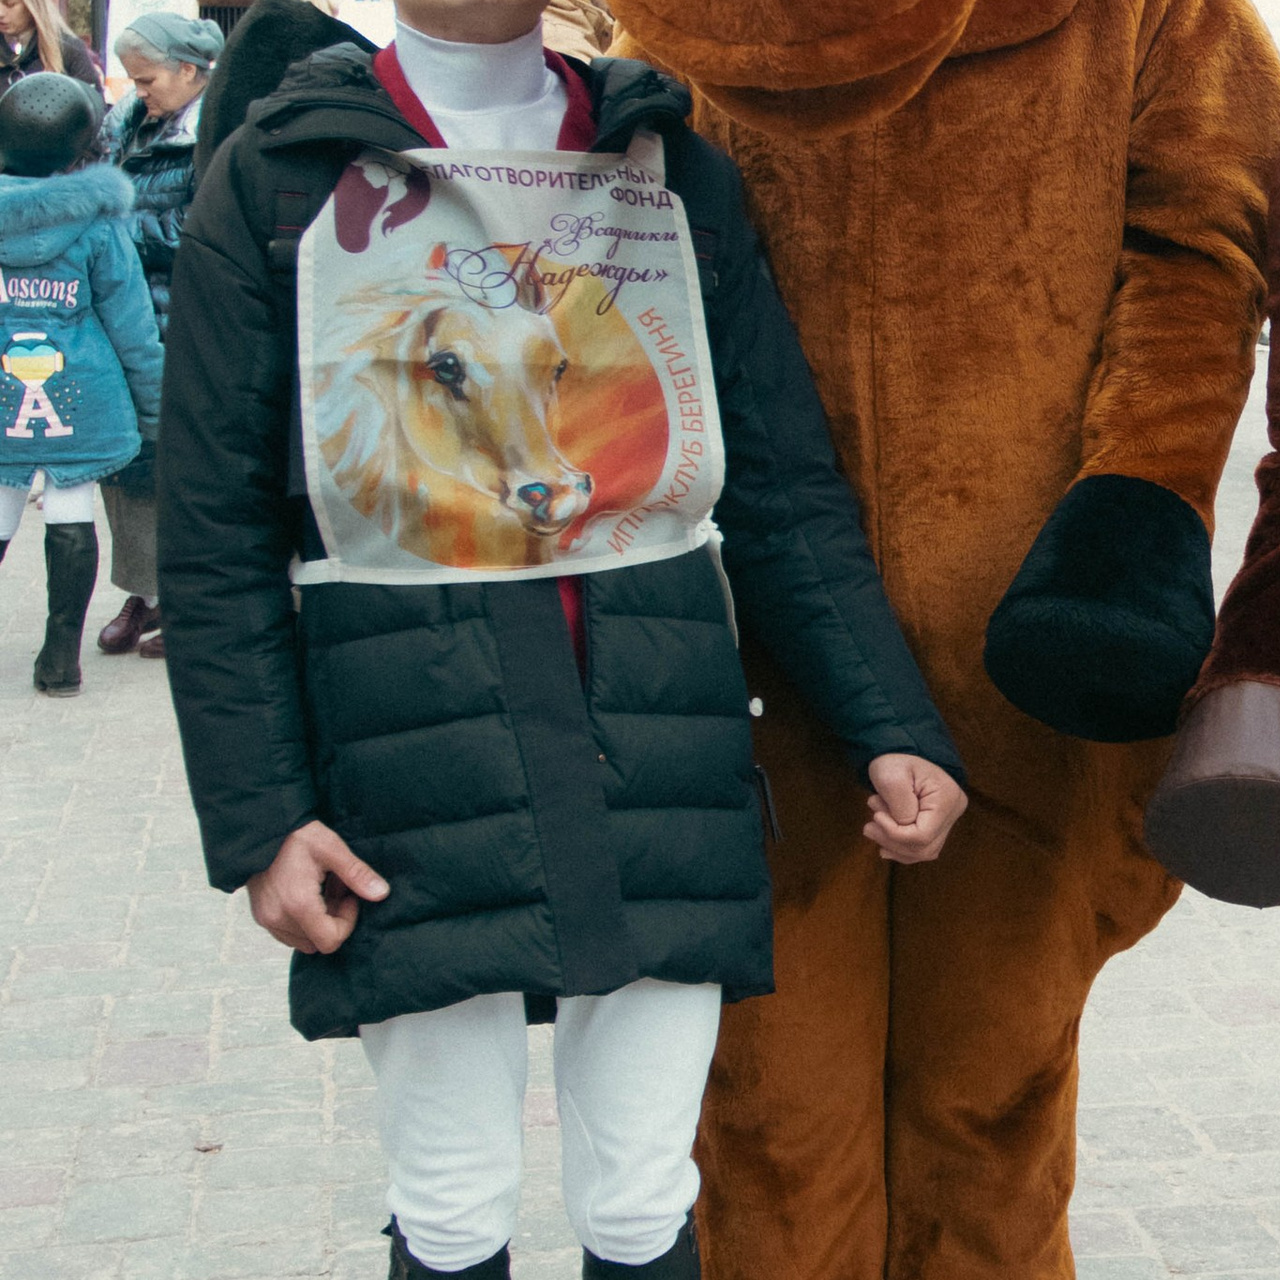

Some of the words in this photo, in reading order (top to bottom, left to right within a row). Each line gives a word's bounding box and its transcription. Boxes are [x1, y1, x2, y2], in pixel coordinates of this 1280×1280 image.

[610, 186, 674, 209] ФОНД
[445, 241, 668, 315] Надежды»
[637, 307, 704, 432] БЕРЕГИНЯ
